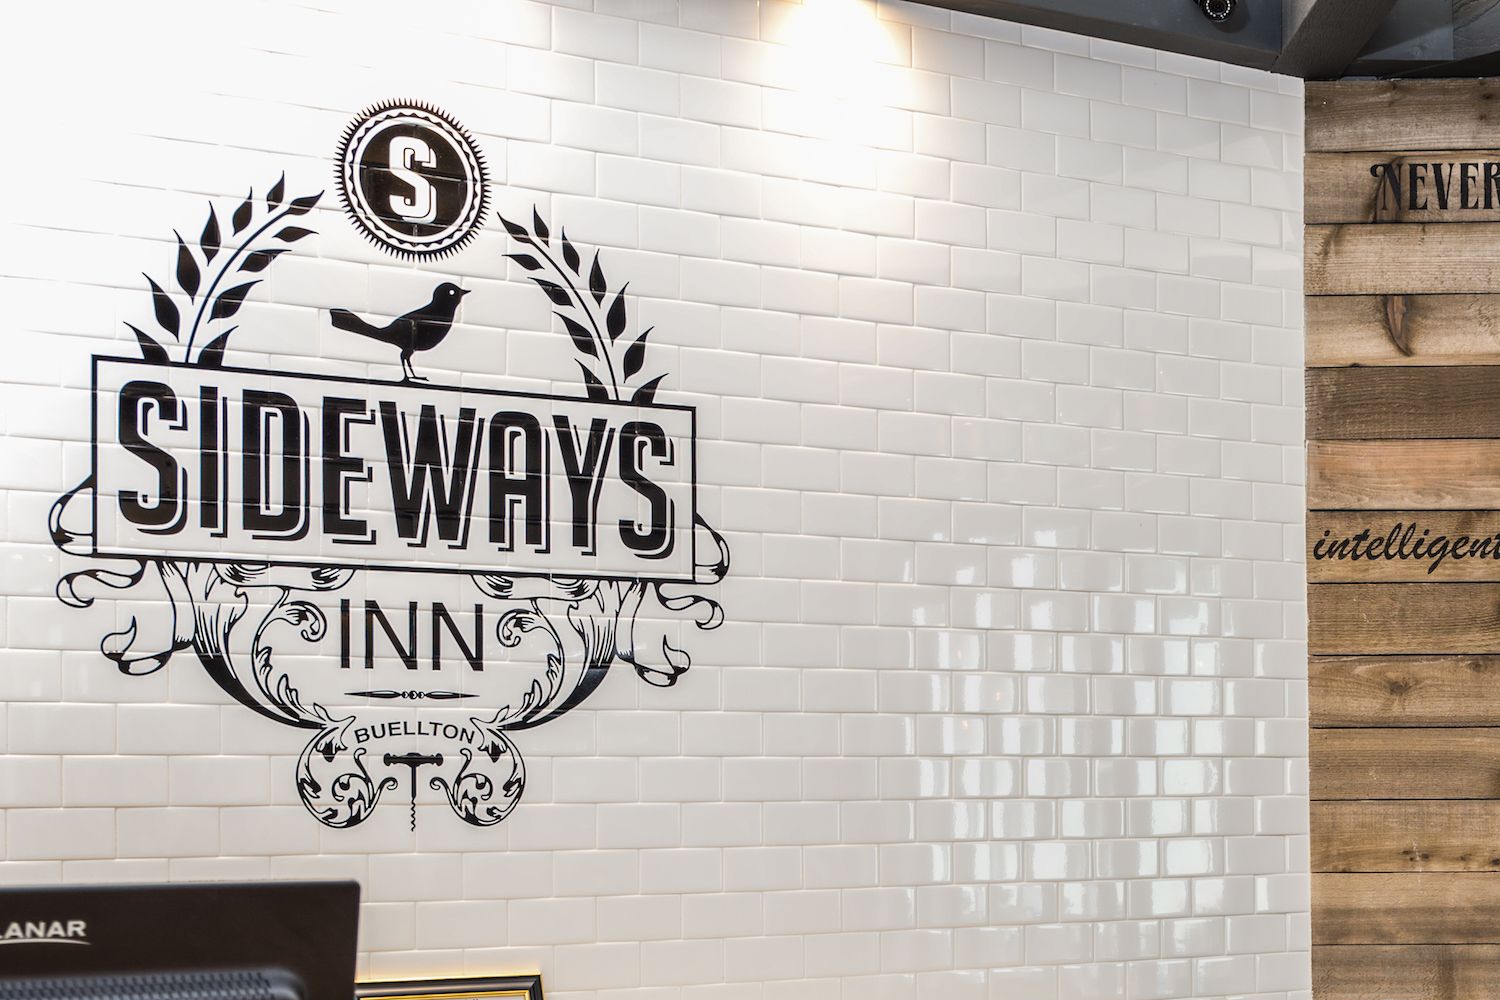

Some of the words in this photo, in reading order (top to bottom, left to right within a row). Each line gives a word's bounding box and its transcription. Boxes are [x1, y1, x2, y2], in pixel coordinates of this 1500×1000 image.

[389, 136, 437, 223] S
[117, 380, 676, 560] SIDEWAYS
[340, 598, 484, 672] INN
[354, 721, 476, 745] BUELLTON
[0, 919, 88, 939] ANAR
